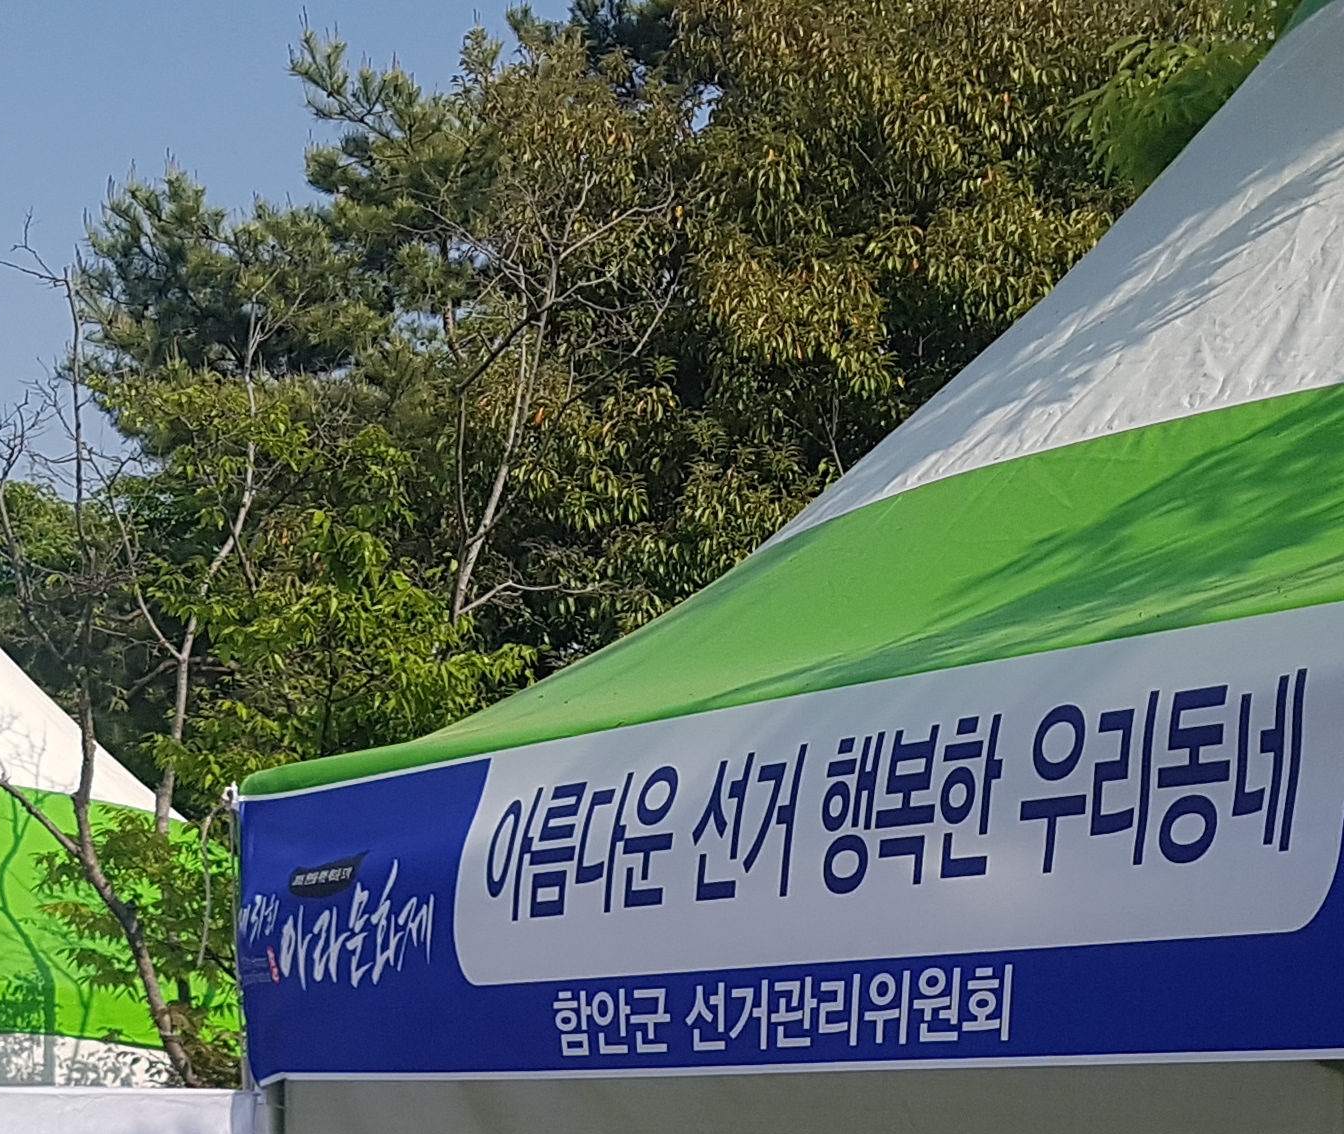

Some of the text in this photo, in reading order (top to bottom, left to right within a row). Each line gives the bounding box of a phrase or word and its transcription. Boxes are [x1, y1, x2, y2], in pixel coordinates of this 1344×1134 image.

[484, 667, 1308, 922] 아름다운 선거 행복한 우리동네
[279, 858, 436, 991] 아라문화제
[552, 962, 1015, 1058] 함안군 선거관리위원회
